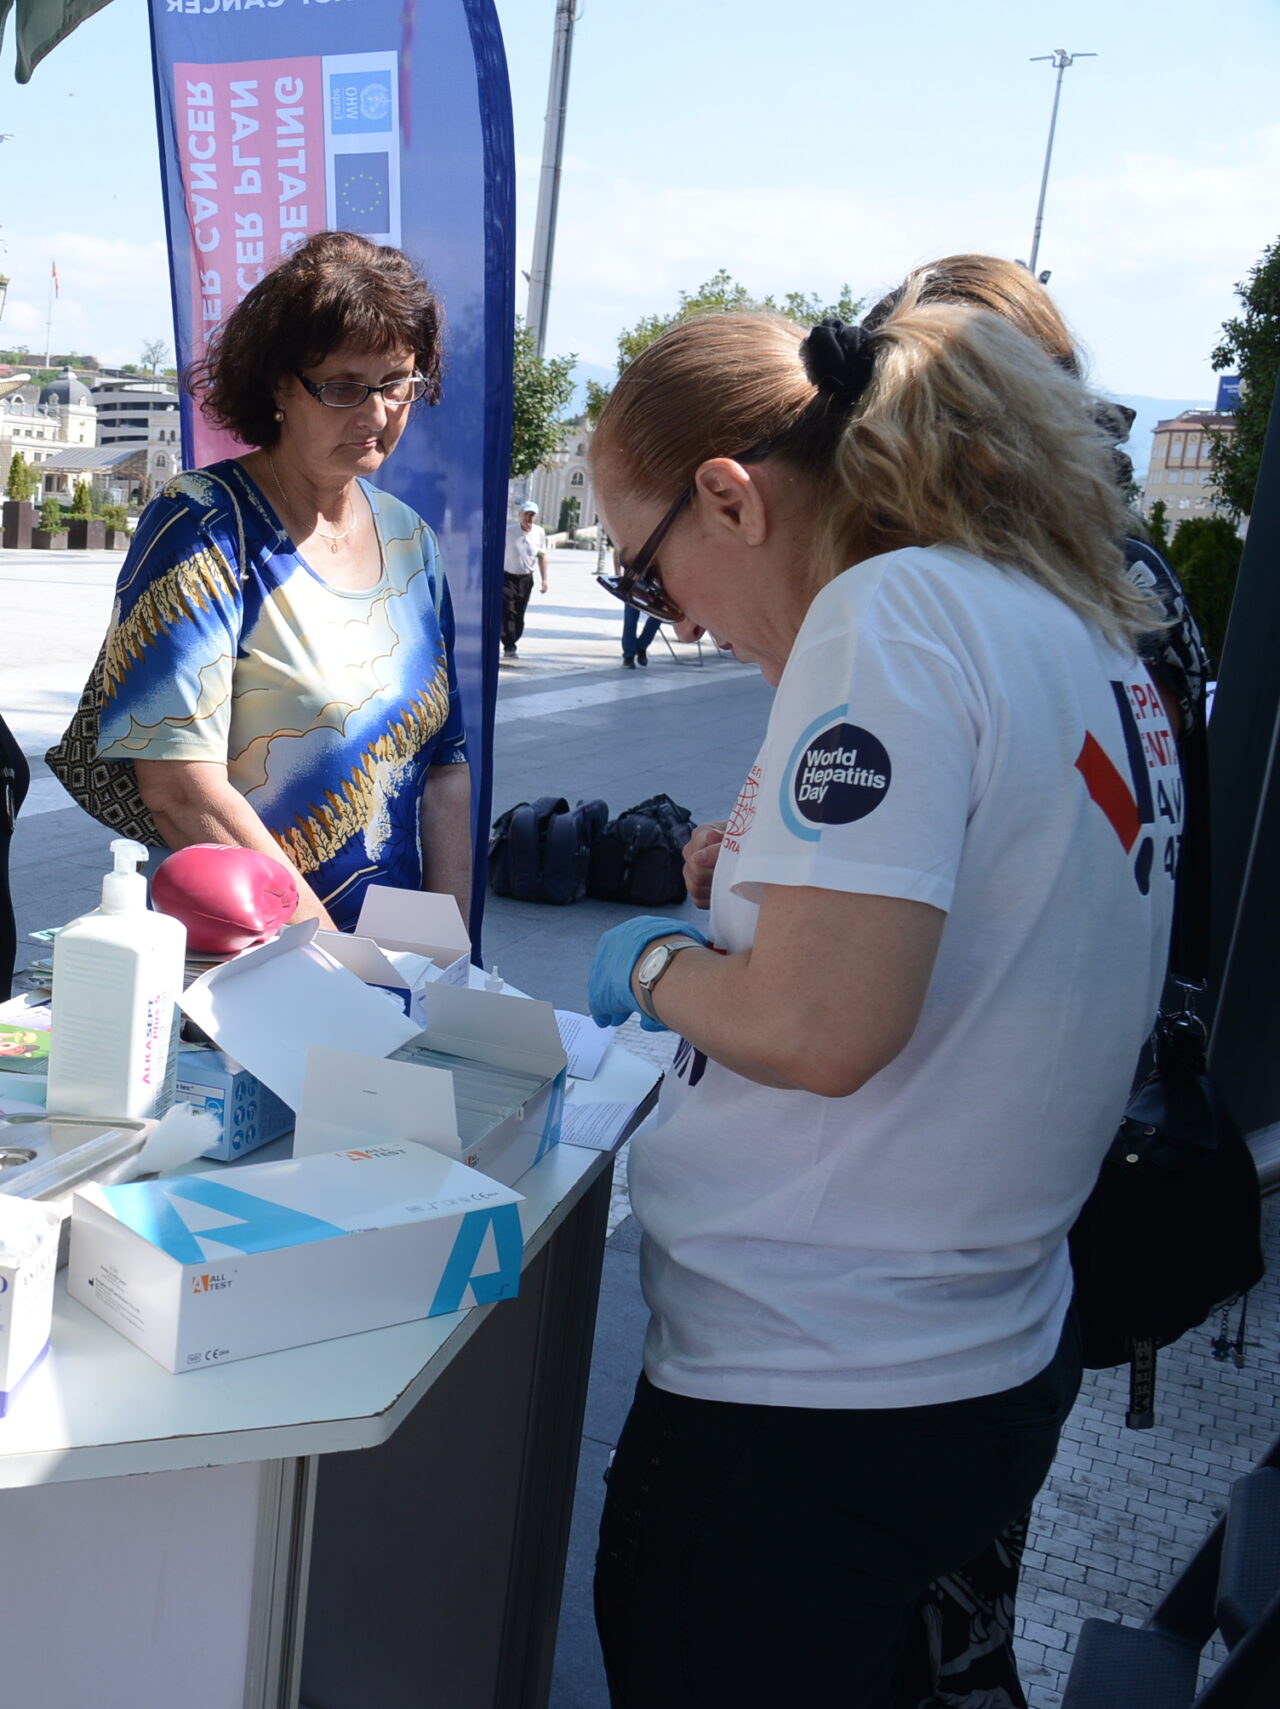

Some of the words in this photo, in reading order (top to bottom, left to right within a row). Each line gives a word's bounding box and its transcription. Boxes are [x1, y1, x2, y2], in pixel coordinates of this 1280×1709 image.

[806, 747, 858, 767] World
[803, 766, 886, 789] Hepatitis
[798, 783, 828, 803] Day
[142, 999, 154, 1084] ALKASEPT
[209, 1274, 226, 1282] ALL
[209, 1280, 233, 1291] TEST
